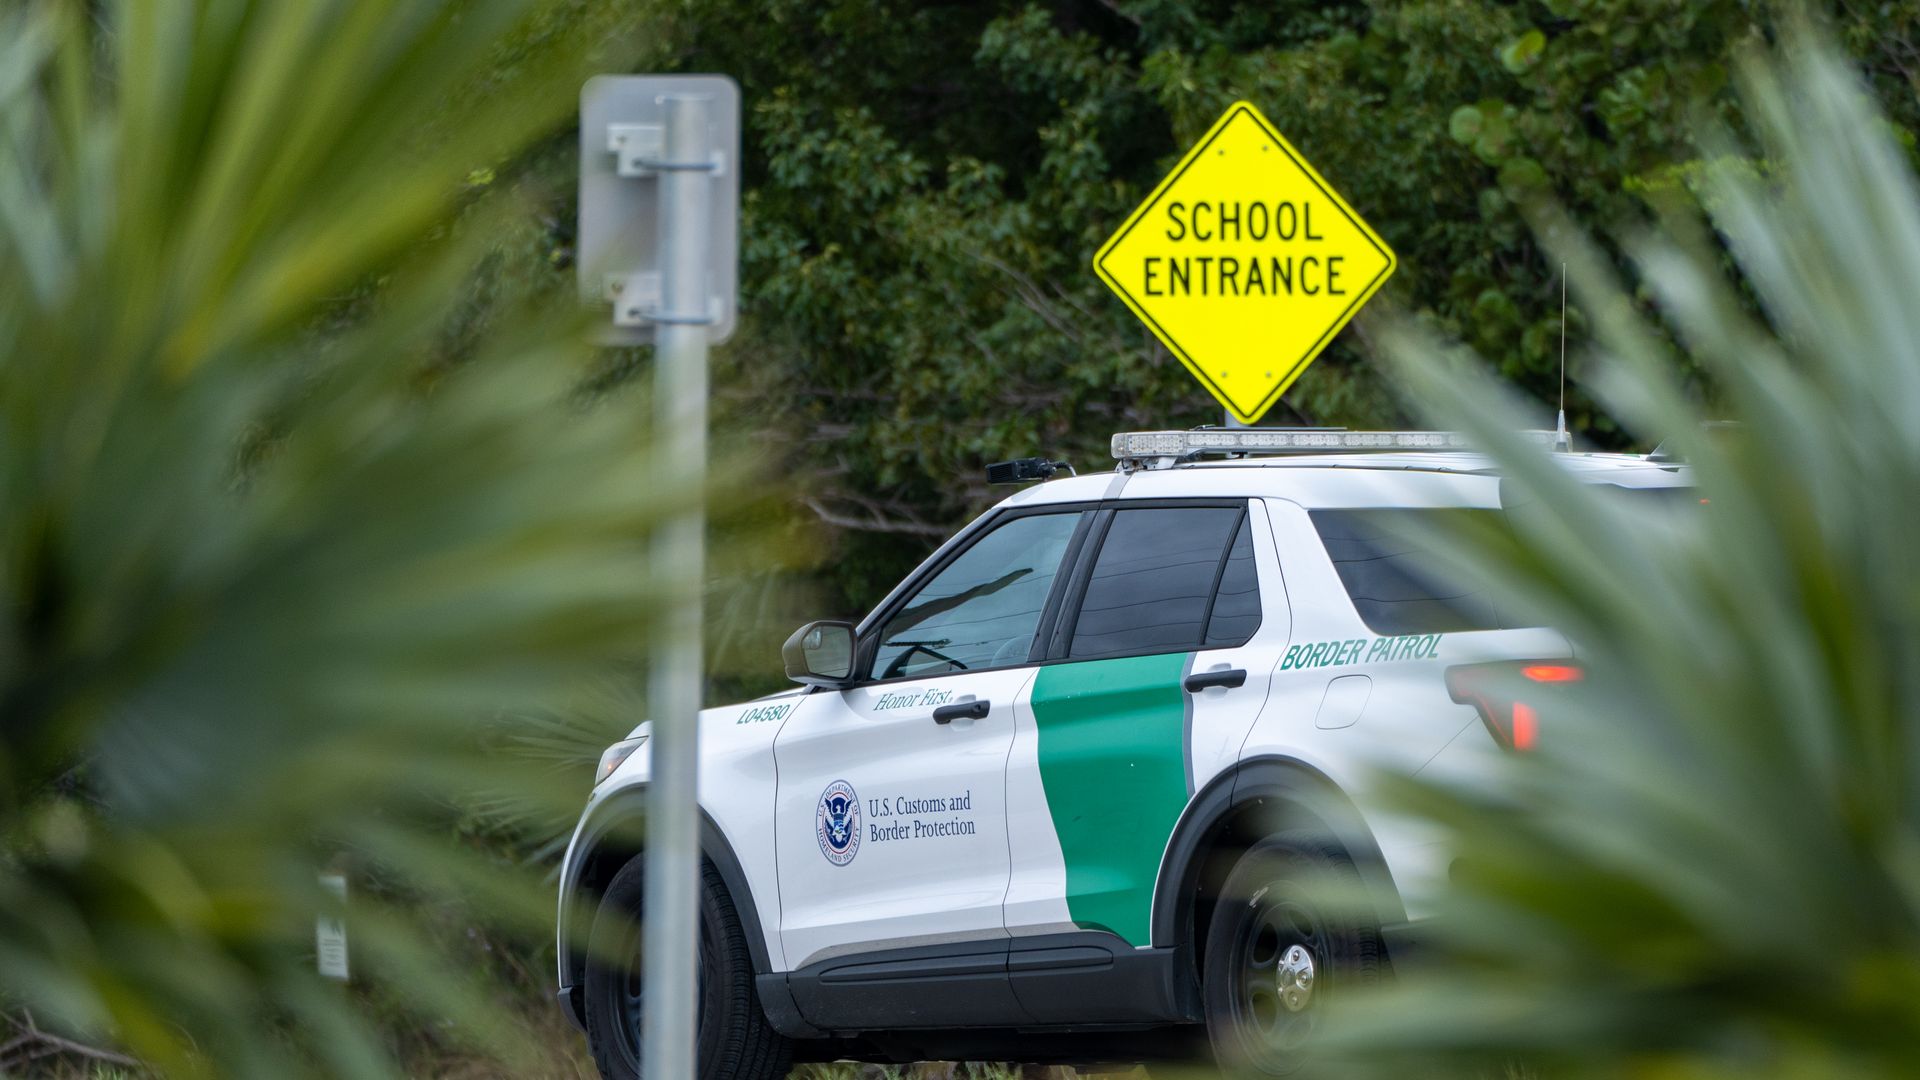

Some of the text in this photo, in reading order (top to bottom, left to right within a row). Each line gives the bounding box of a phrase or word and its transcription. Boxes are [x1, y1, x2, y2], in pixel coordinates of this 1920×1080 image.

[1166, 201, 1324, 242] SCHOOL
[1144, 256, 1346, 297] ENTRANCE
[1280, 633, 1443, 671] BORDER PATROL
[873, 693, 920, 711] Honor
[869, 790, 971, 818] U.S. Customs and
[870, 817, 976, 842] Border Protection
